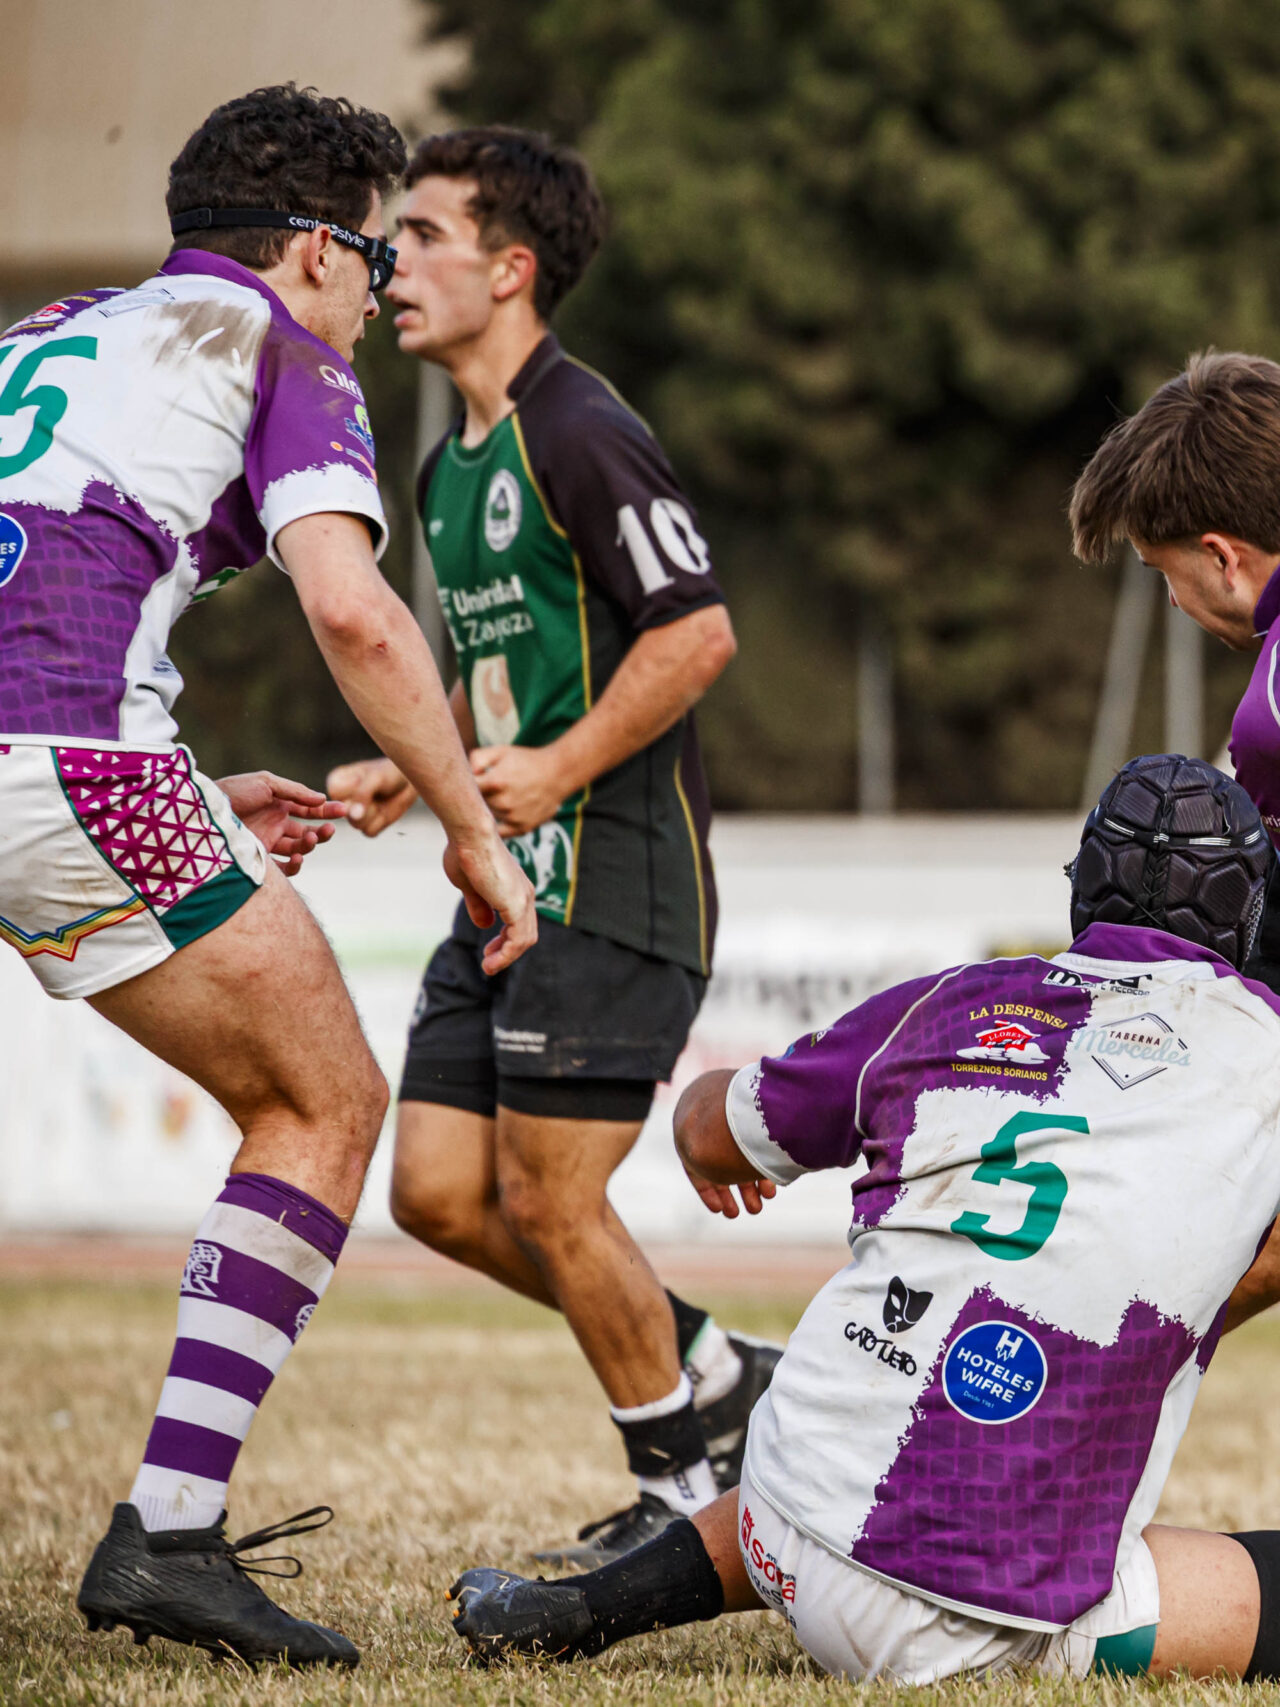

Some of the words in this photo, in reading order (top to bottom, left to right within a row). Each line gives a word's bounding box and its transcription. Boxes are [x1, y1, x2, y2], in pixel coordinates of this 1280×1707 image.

[288, 215, 365, 248] centostyle
[0, 335, 98, 480] 5
[614, 497, 711, 597] 10
[969, 1006, 989, 1021] LA
[993, 1003, 1068, 1029] DESPENSA
[1073, 1027, 1191, 1067] Mercedes
[1109, 1030, 1161, 1046] TABERNA
[951, 1063, 1002, 1076] TORREZNOS
[1003, 1067, 1048, 1081] SORIANOS
[951, 1110, 1090, 1261] 5
[957, 1346, 1035, 1392] HOTELES
[961, 1367, 1016, 1404] WIFRE
